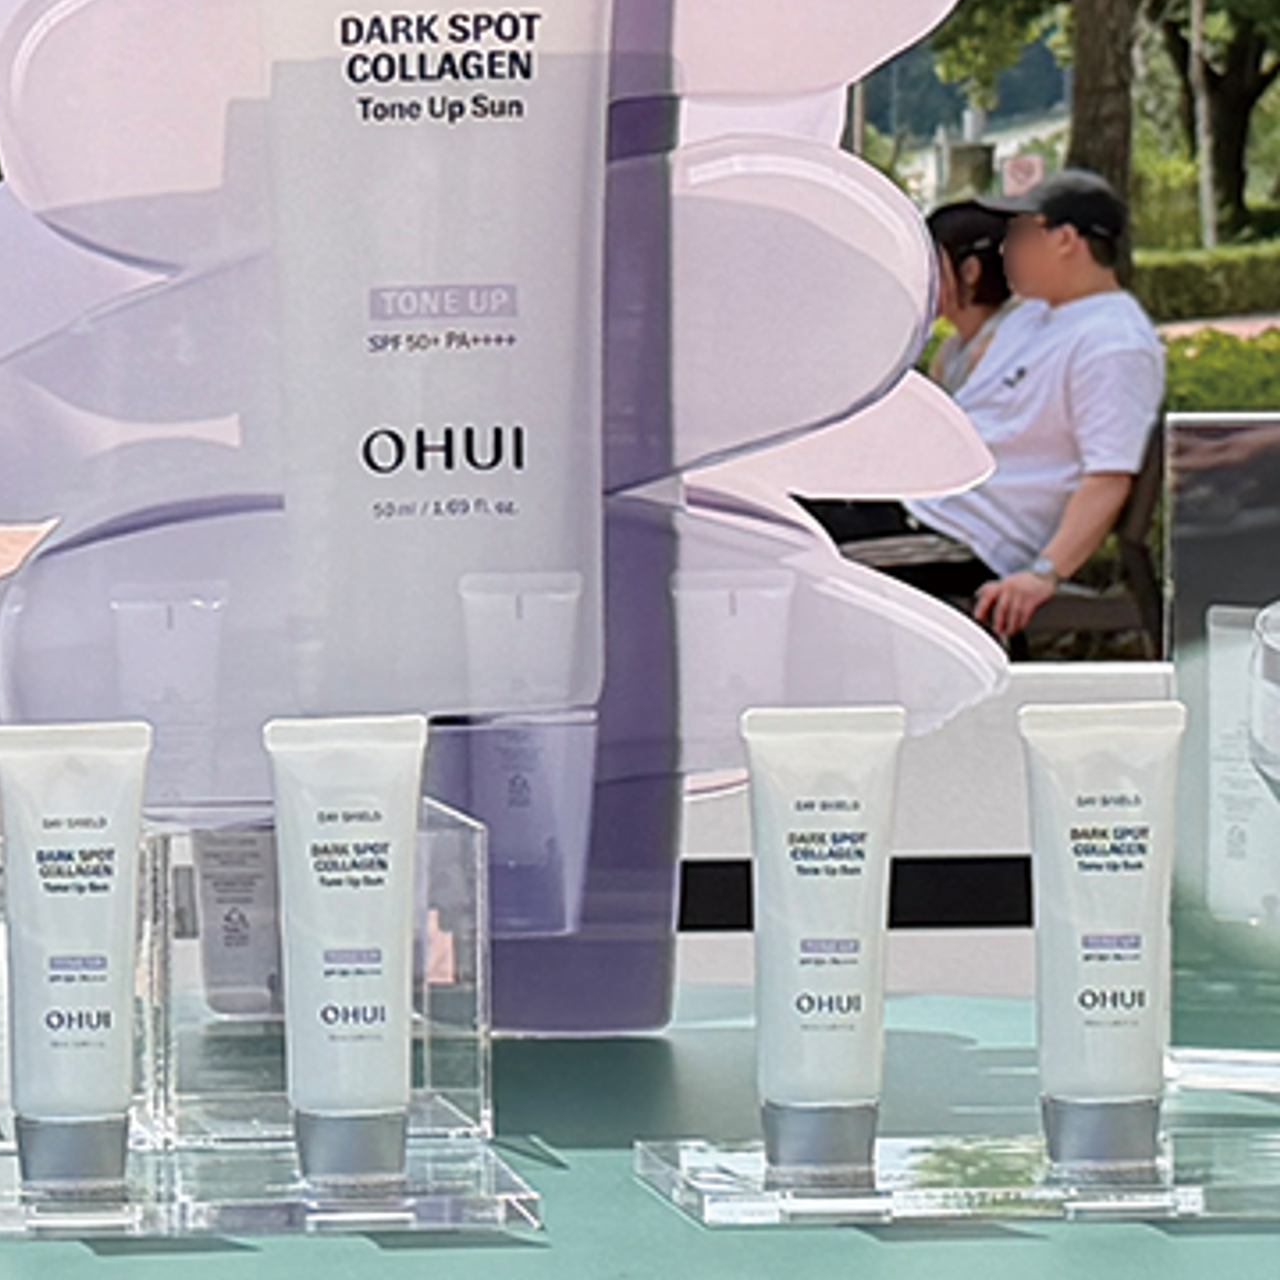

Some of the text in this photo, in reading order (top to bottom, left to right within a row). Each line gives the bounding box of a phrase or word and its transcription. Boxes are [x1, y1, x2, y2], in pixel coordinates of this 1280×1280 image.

[339, 12, 541, 46] DARK SPOT
[345, 50, 534, 84] COLLAGEN
[357, 94, 524, 126] Tone Up Sun
[379, 287, 510, 316] TONE UP
[361, 425, 525, 474] OHUI
[787, 831, 869, 846] DARK SPOT
[1070, 826, 1150, 841] DARK SPOT
[36, 848, 116, 863] DARK SPOT
[310, 842, 390, 857] DARK SPOT
[790, 847, 866, 861] COLLAGEN
[1073, 843, 1147, 858] COLLAGEN
[38, 864, 114, 879] COLLAGEN
[313, 858, 388, 873] COLLAGEN
[795, 993, 862, 1014] OHUI
[1077, 987, 1146, 1009] OHUI
[45, 1010, 112, 1031] OHUI
[319, 1004, 386, 1025] OHUI
